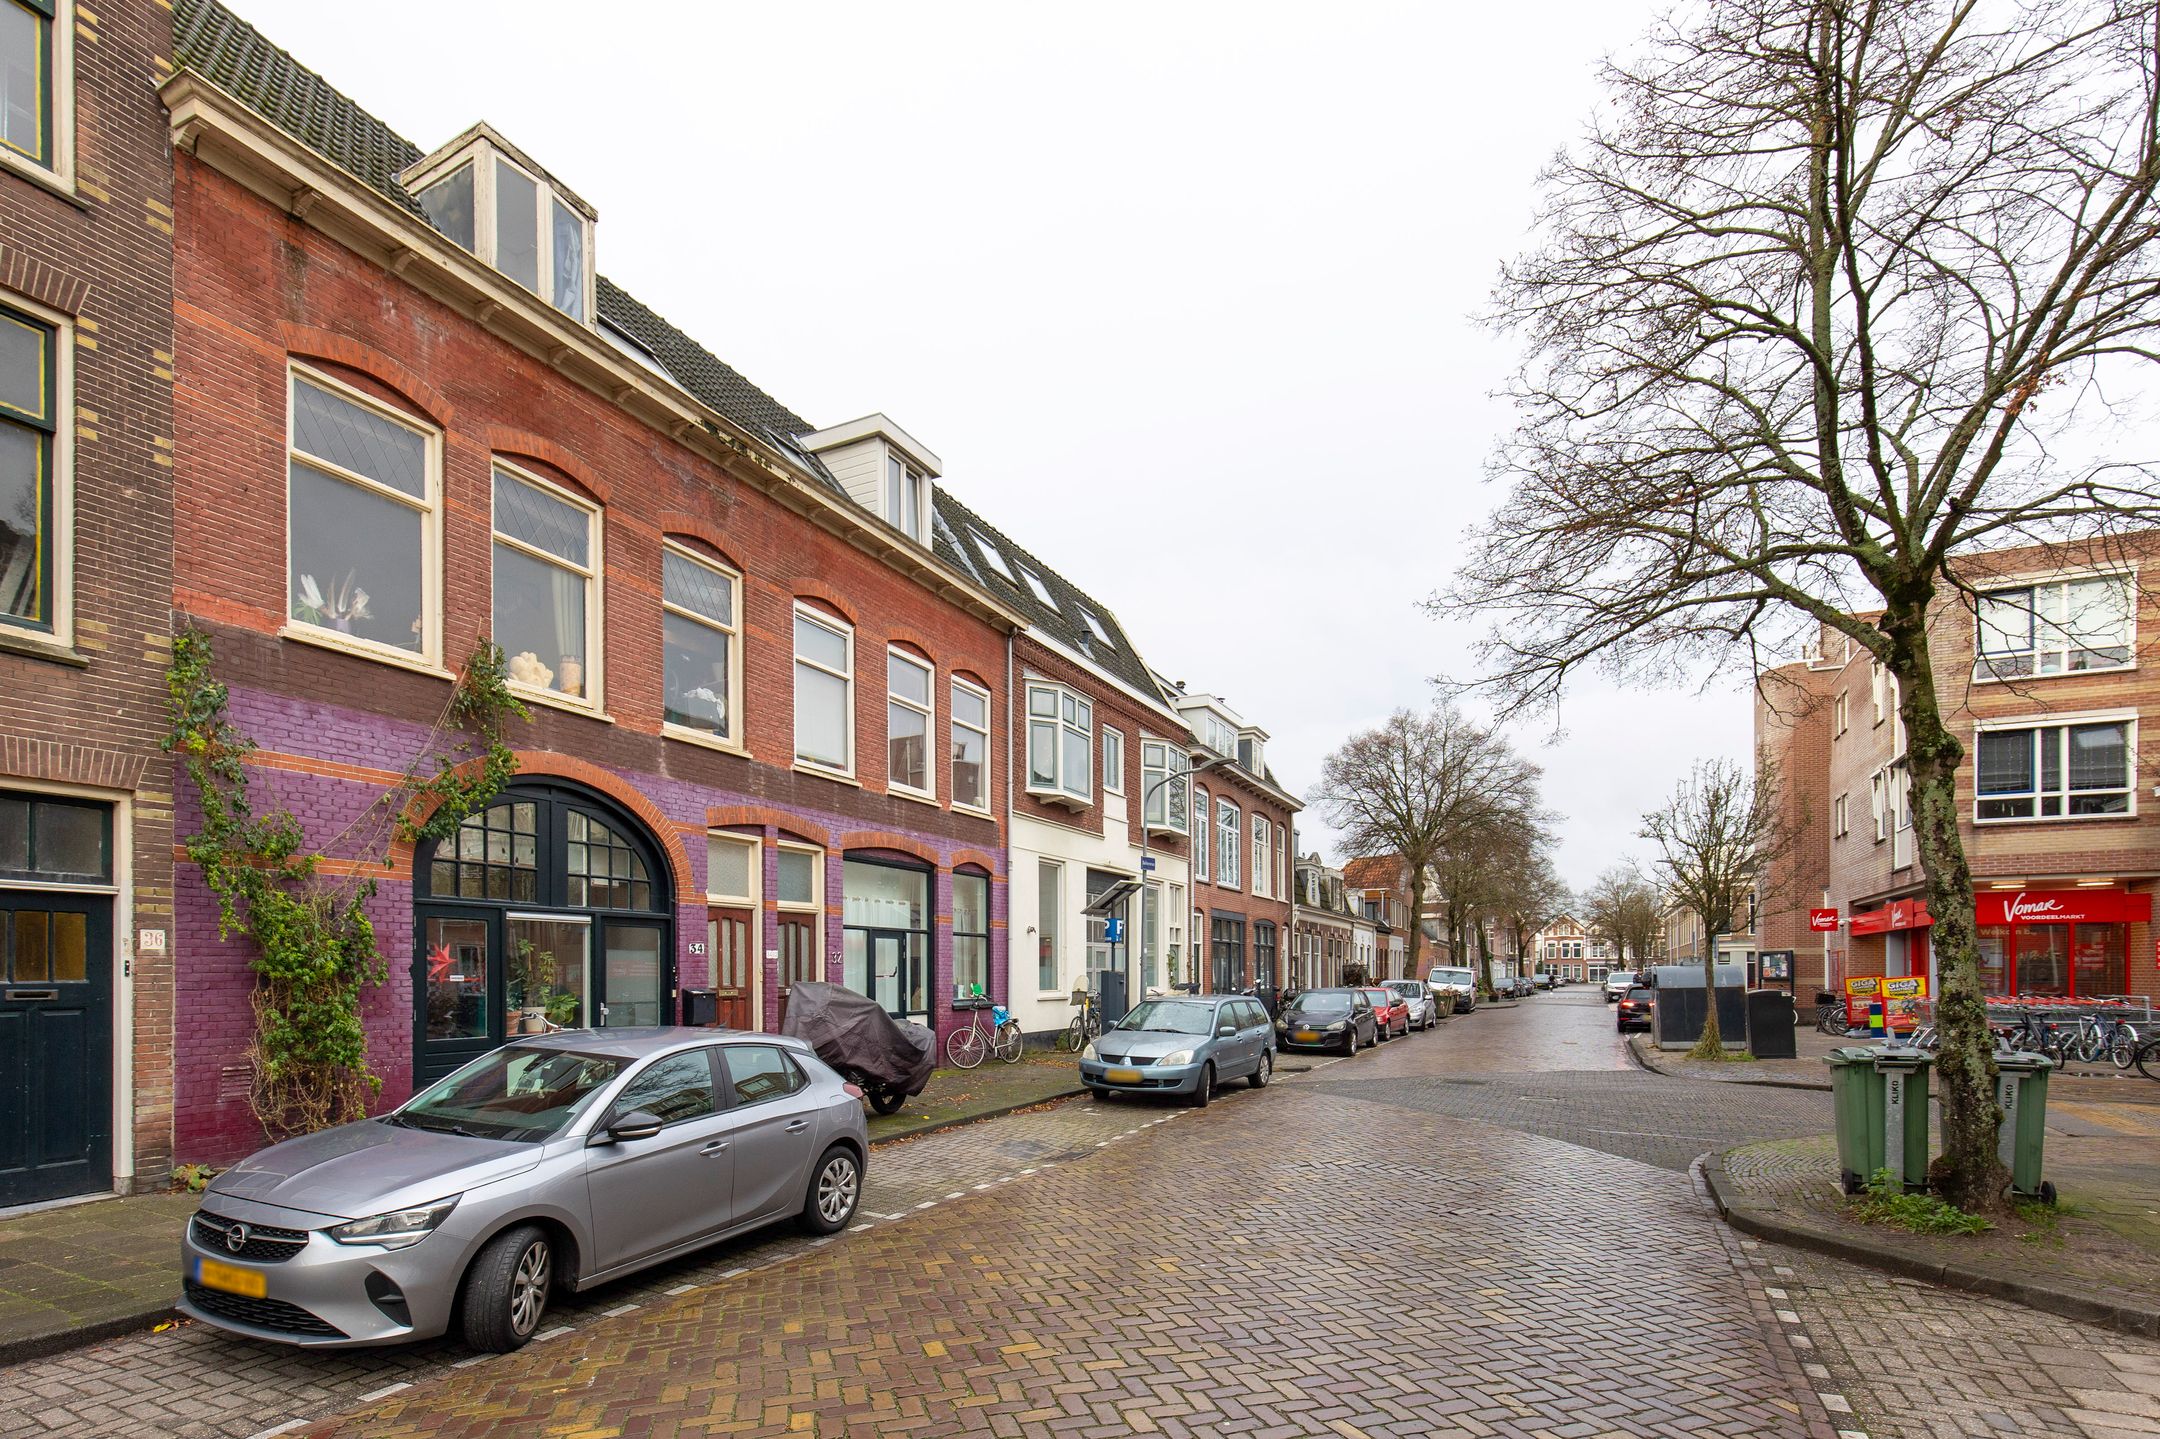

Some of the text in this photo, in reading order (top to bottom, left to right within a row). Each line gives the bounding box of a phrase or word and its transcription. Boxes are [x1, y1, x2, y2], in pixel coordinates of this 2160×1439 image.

[2003, 892, 2064, 922] Vomar
[144, 931, 163, 946] 36
[690, 943, 704, 954] 34
[832, 952, 842, 964] 32
[1851, 978, 1876, 987] GIGA
[1887, 979, 1918, 988] GIGA
[1891, 1080, 1899, 1105] KLIKO
[2005, 1084, 2014, 1109] KLIKO
